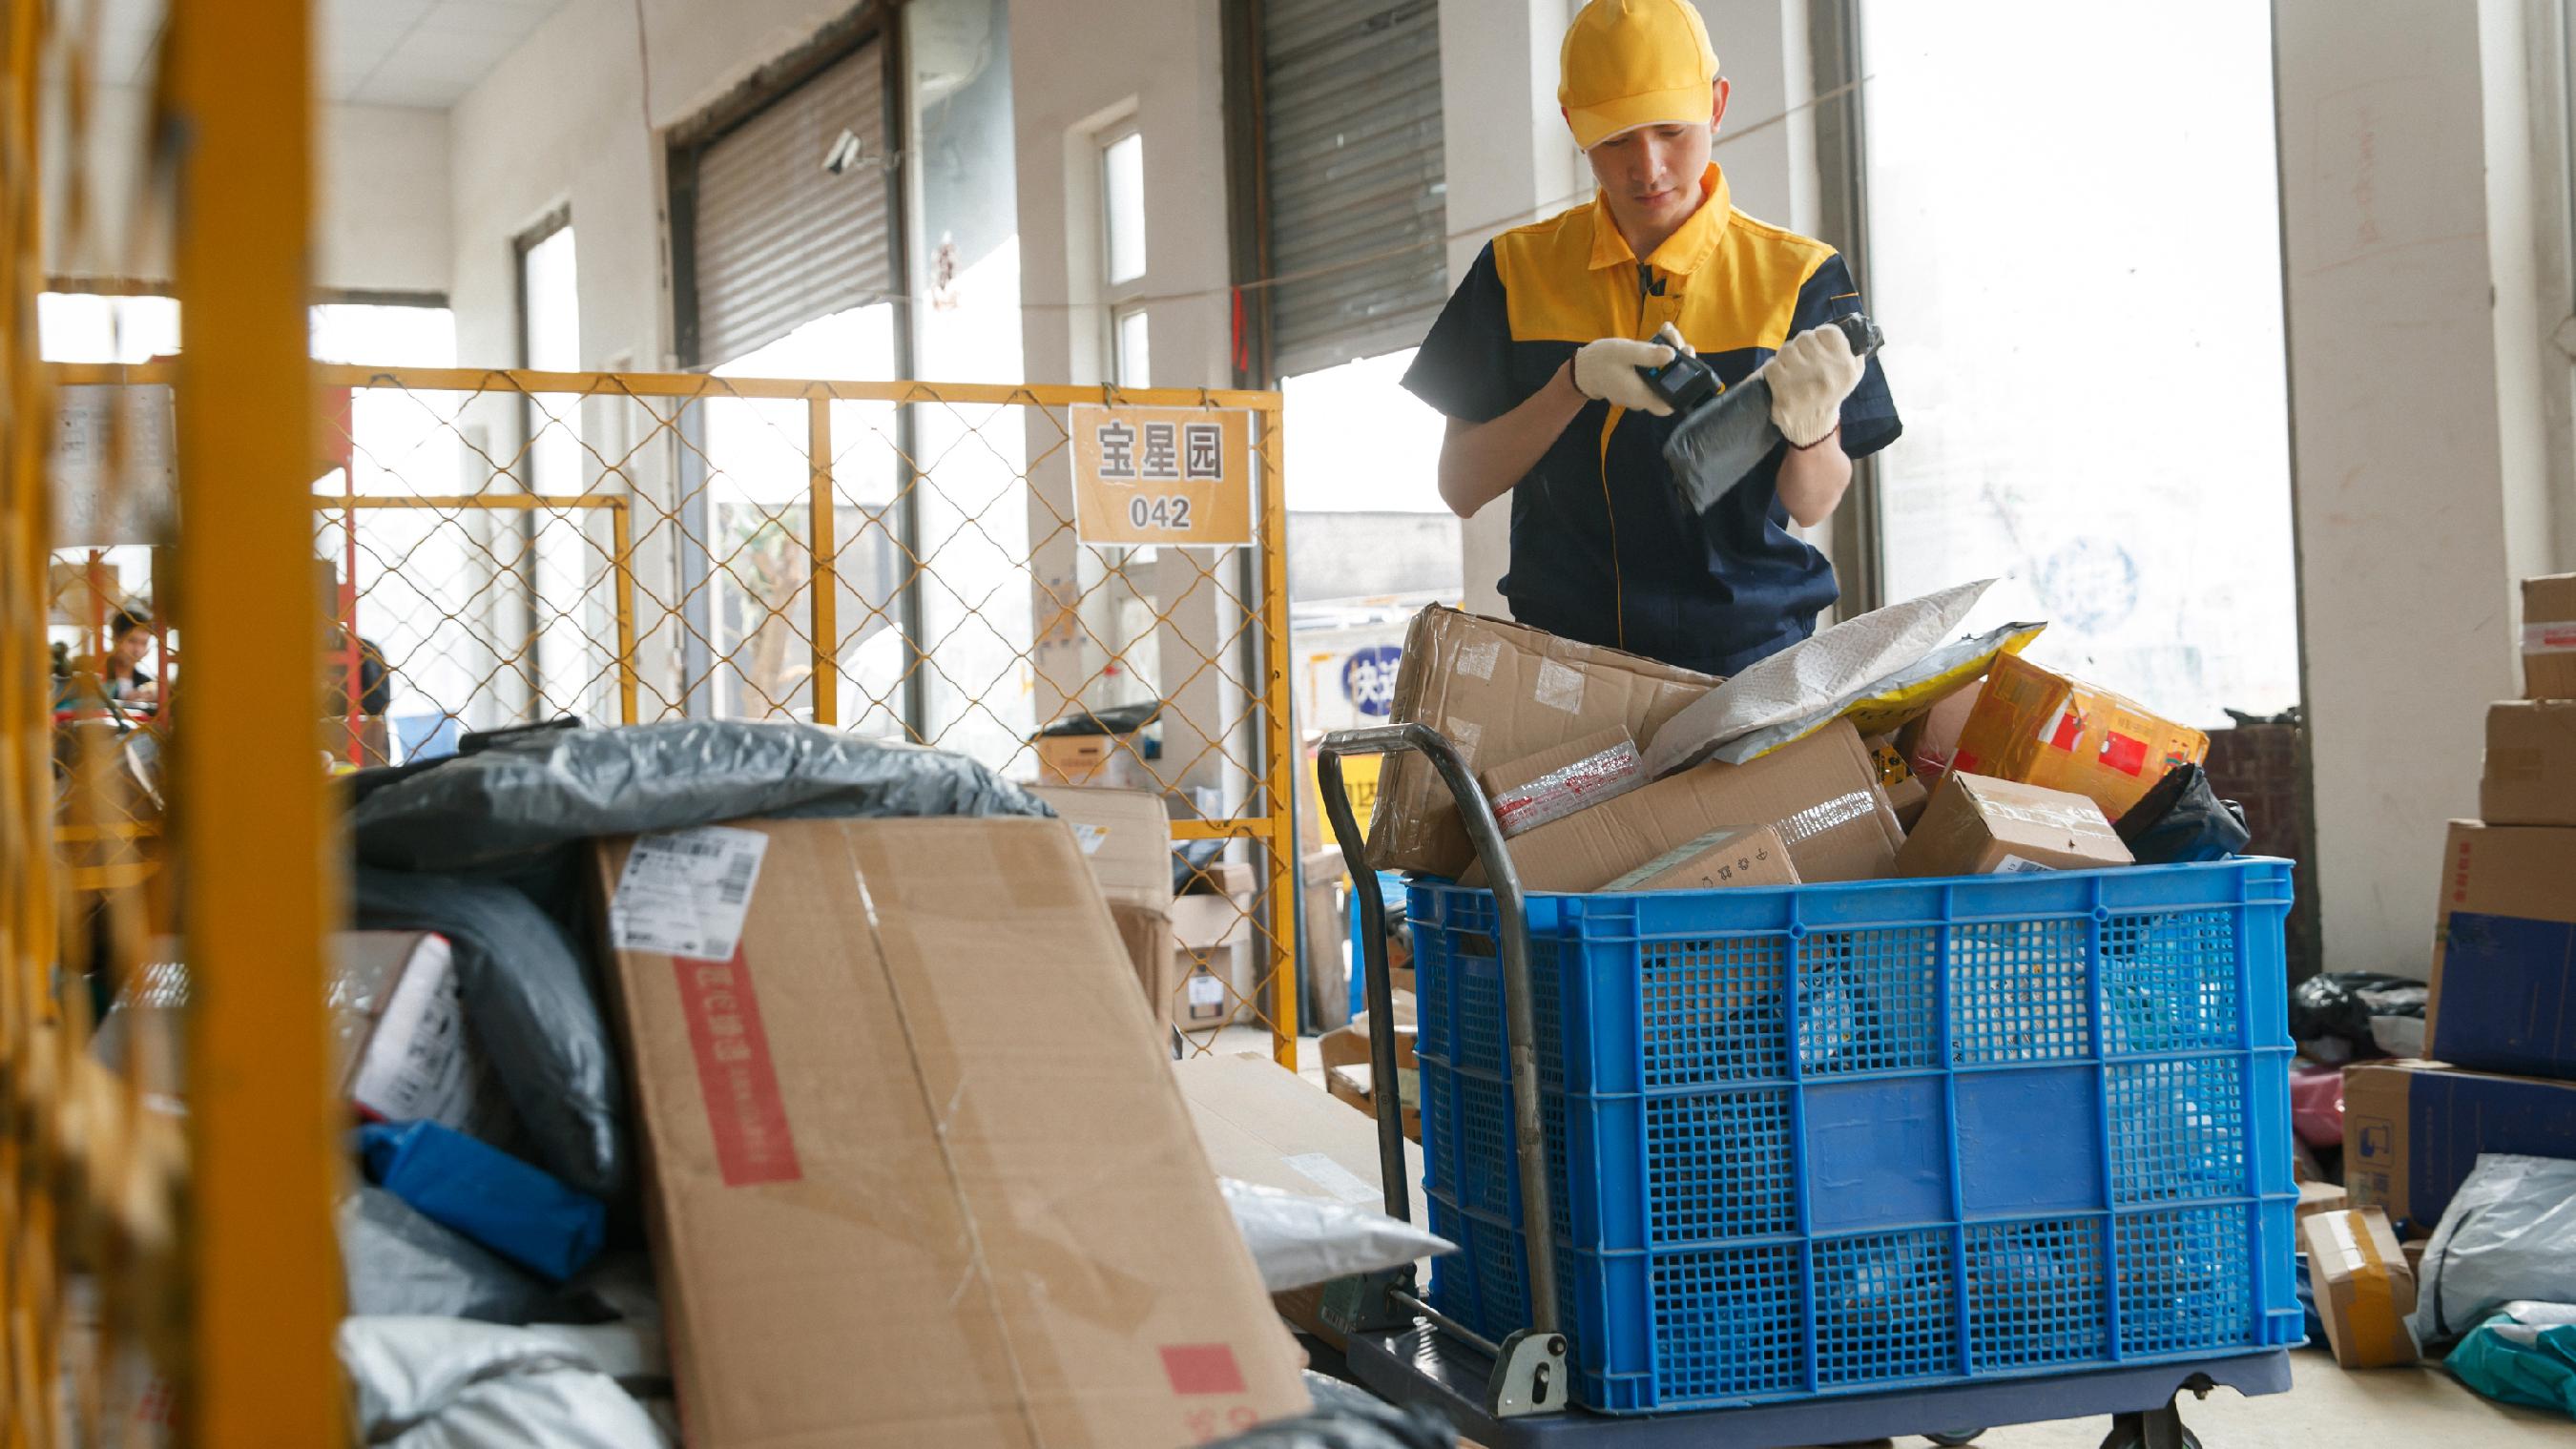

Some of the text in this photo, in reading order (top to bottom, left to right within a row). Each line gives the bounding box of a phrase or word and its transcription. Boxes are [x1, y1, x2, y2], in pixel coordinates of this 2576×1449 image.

[1098, 421, 1222, 479] 宝星园
[1131, 496, 1191, 528] 042
